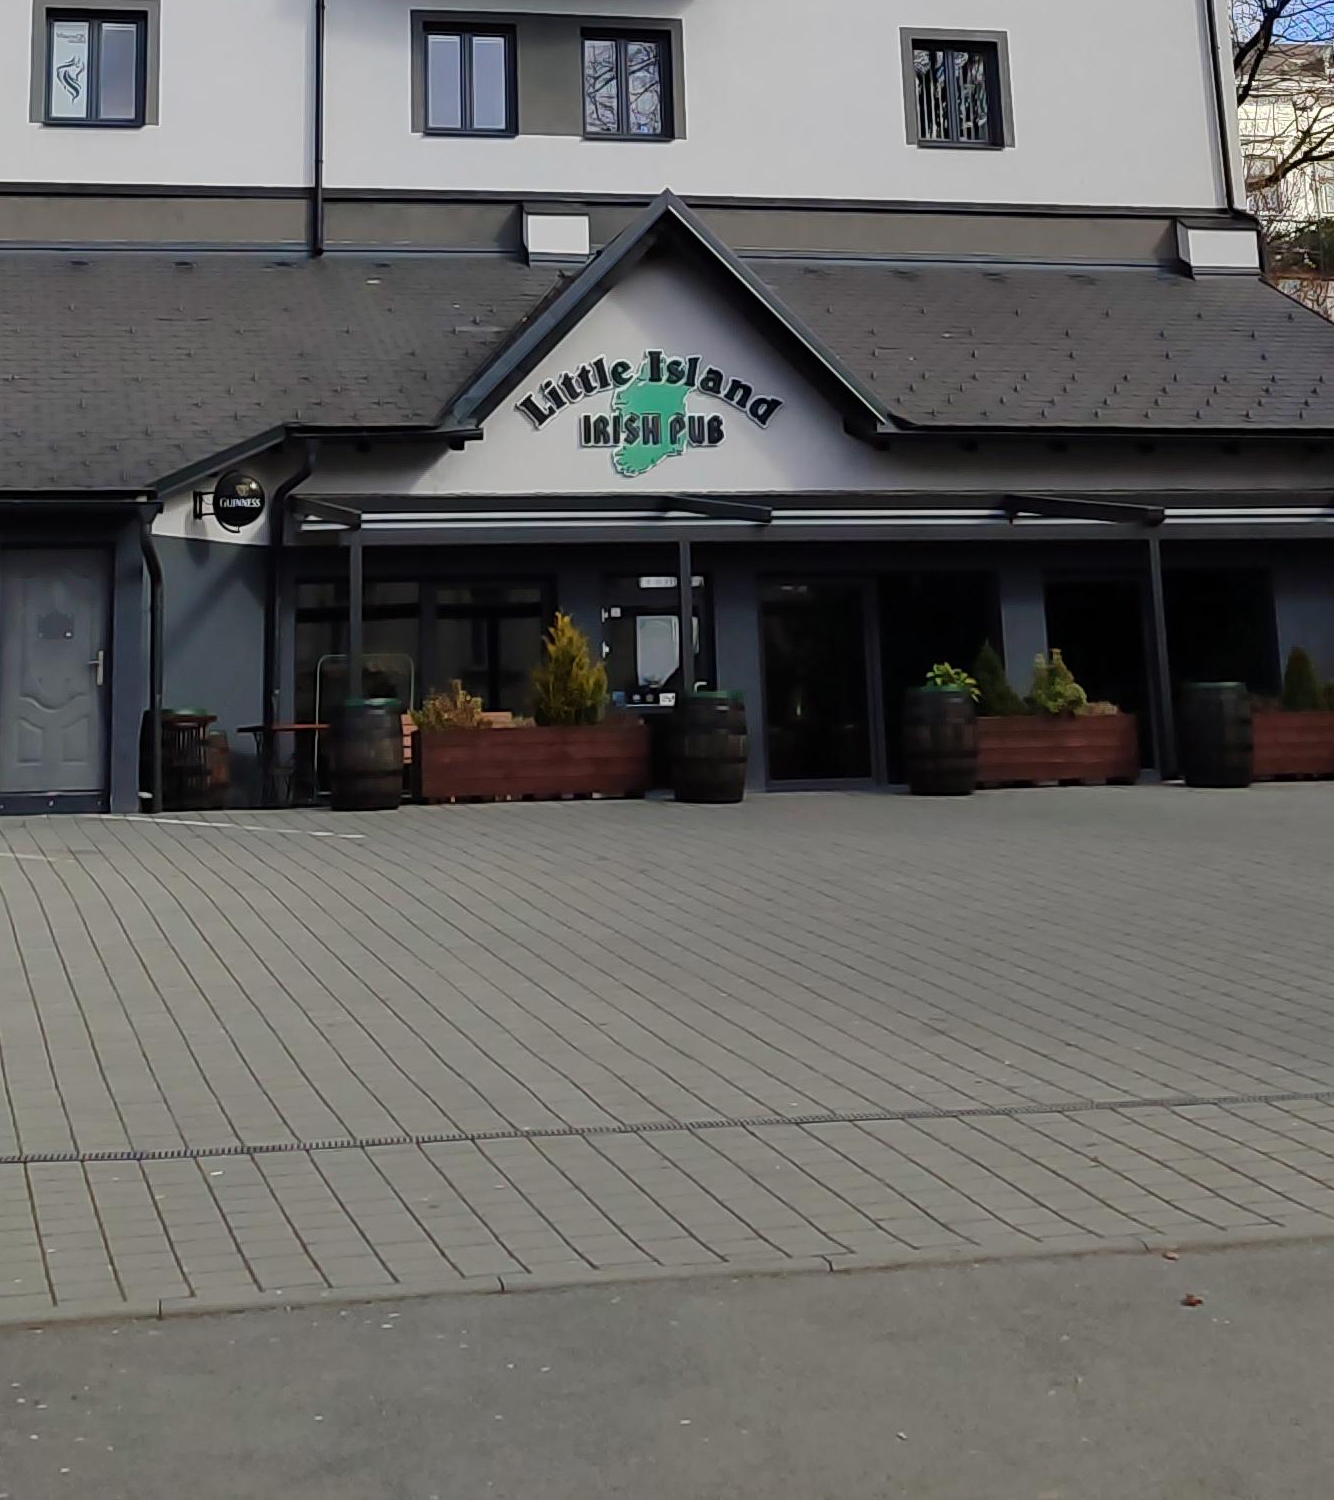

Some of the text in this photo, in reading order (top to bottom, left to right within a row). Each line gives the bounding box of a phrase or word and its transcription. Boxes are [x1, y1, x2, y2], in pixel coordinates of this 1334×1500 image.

[517, 350, 784, 428] Little Island
[582, 413, 725, 446] IRISH PUB
[219, 498, 261, 508] GUINNESS
